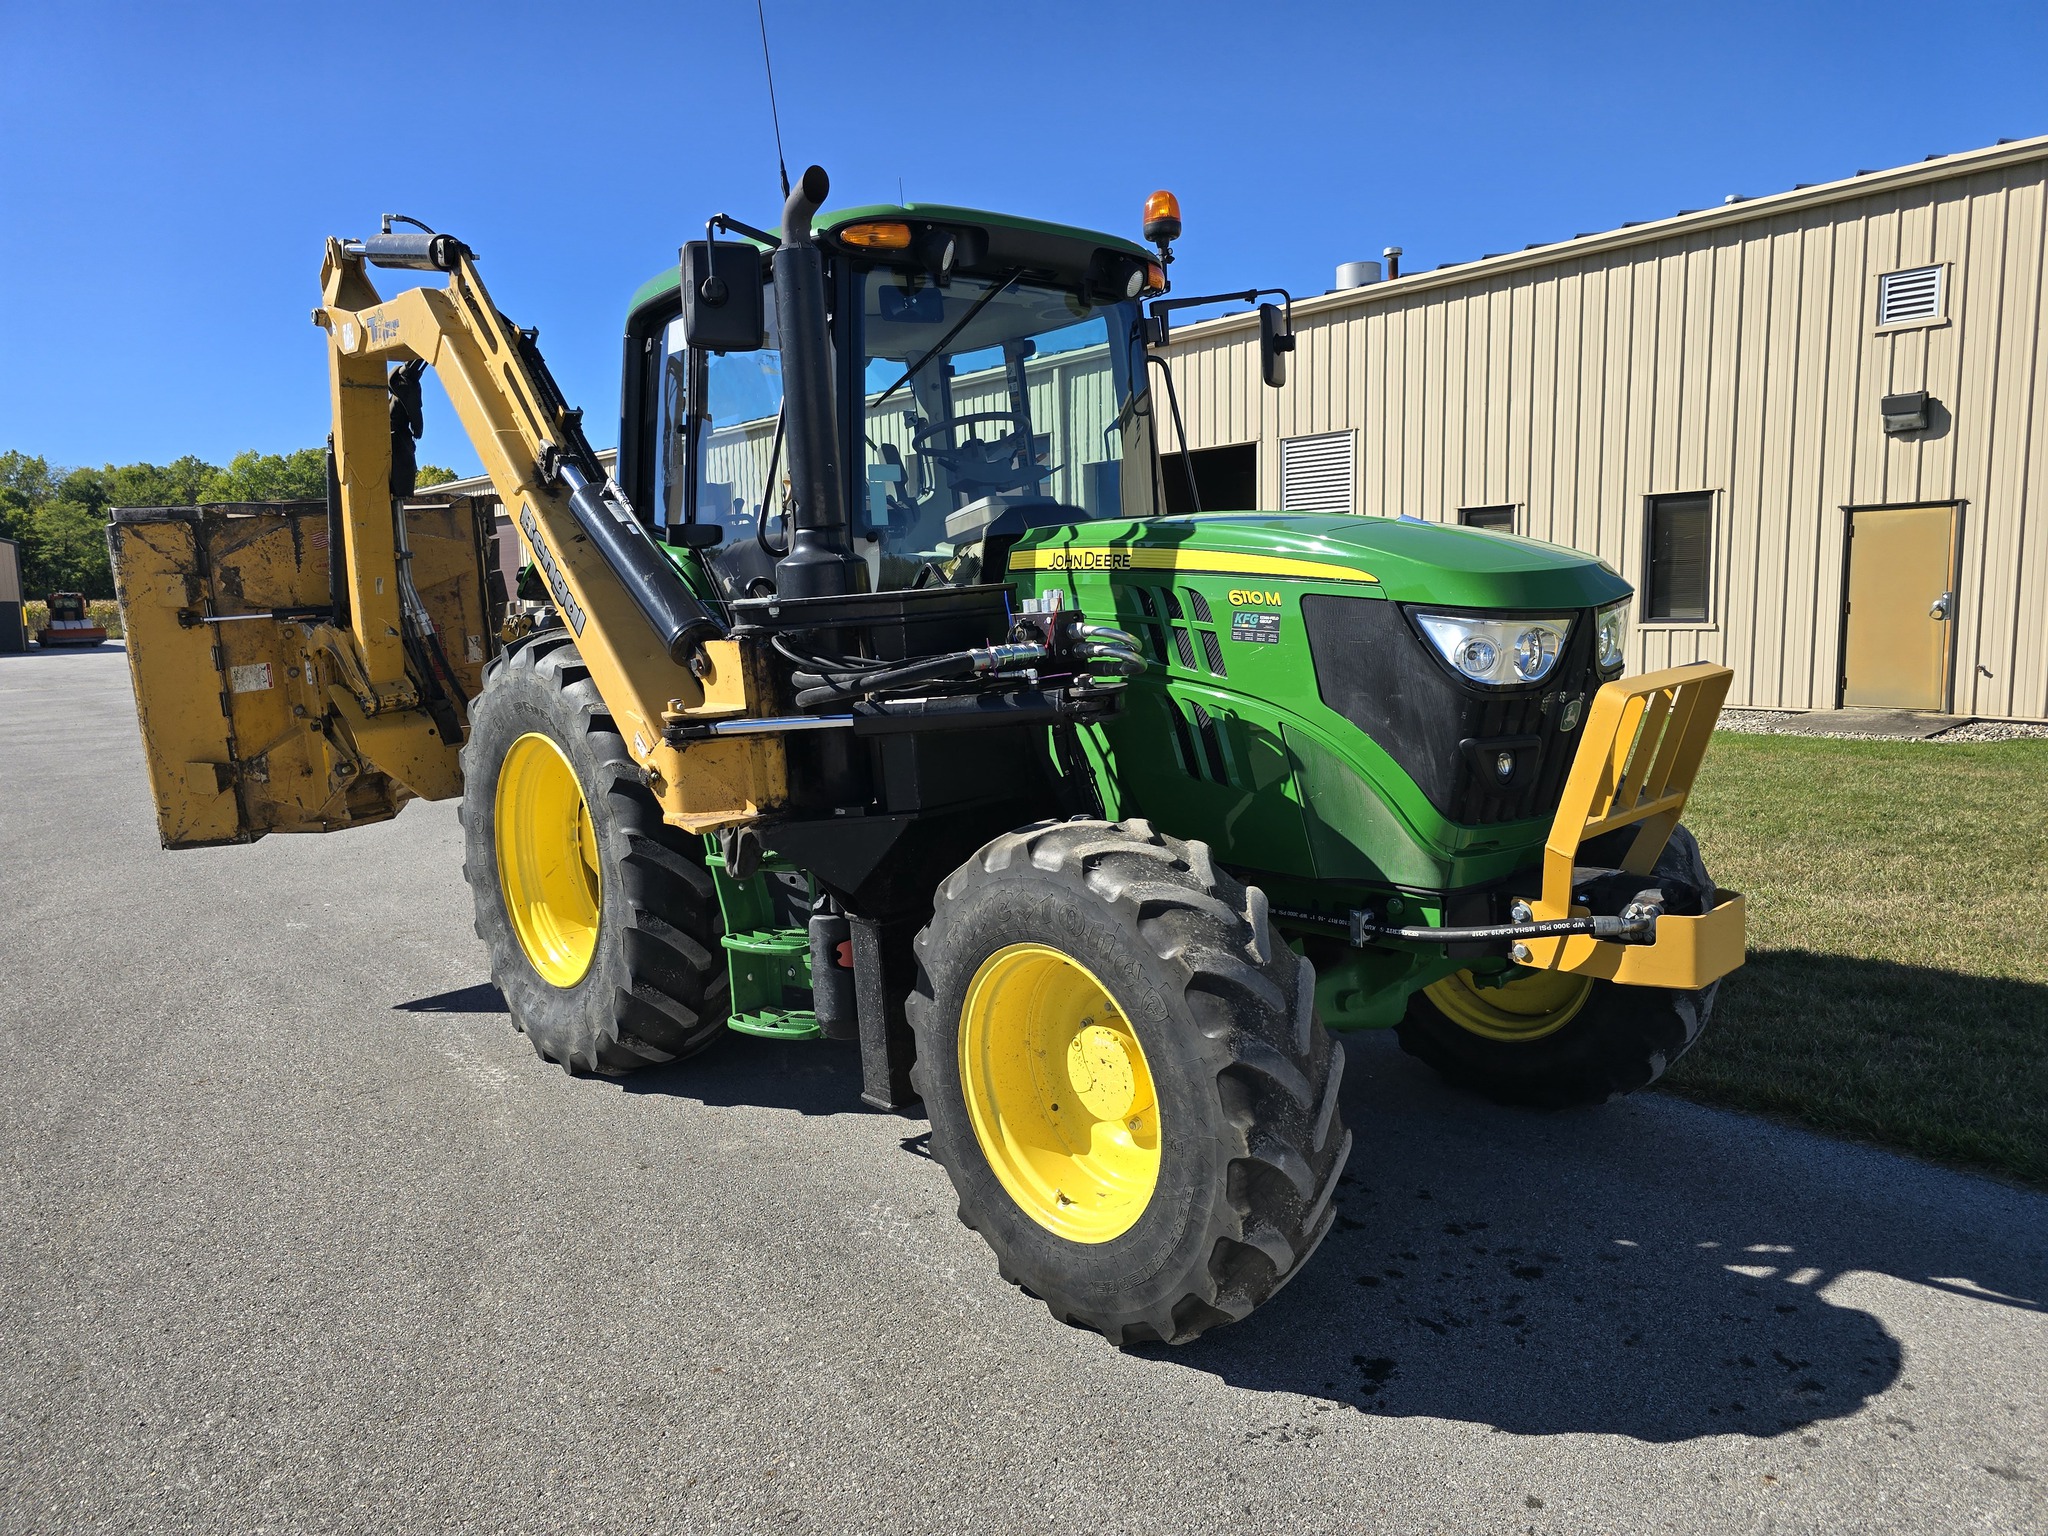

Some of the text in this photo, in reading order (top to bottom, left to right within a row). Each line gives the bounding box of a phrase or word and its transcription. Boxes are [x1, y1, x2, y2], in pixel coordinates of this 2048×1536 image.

[1048, 551, 1132, 568] JOHN DEERE
[519, 501, 587, 639] Bengal
[1234, 613, 1259, 625] KFG
[1515, 925, 1536, 934] MSHA
[1119, 1183, 1196, 1292] PERFORMER
